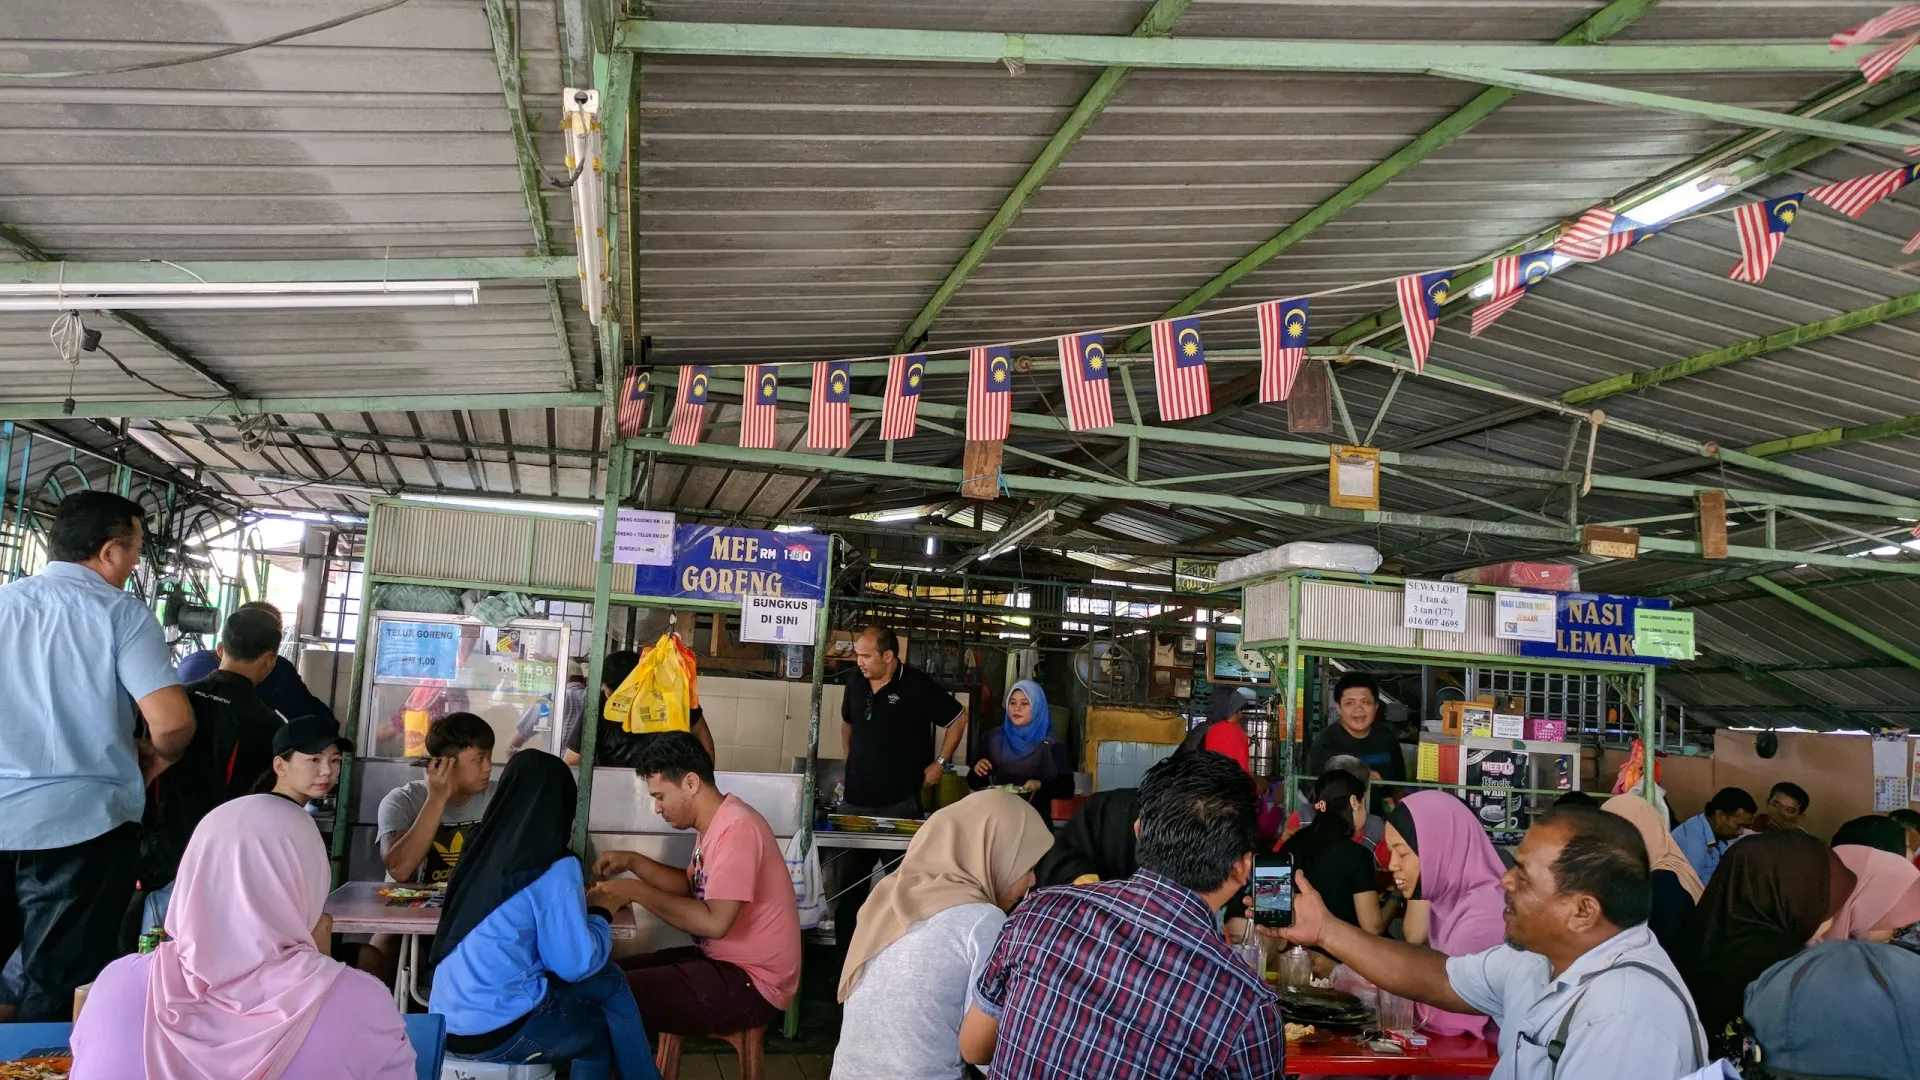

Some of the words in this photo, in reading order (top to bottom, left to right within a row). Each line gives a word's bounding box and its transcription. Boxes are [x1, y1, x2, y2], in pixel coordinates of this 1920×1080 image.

[710, 535, 759, 563] MEE
[760, 548, 777, 560] RM
[682, 565, 782, 598] GORENG
[1408, 582, 1434, 592] SEWA
[1437, 584, 1460, 594] LORI
[753, 599, 808, 610] BUNGKUS
[1419, 594, 1423, 602] 1
[1425, 595, 1439, 604] tan
[1441, 596, 1449, 605] &
[1412, 605, 1418, 613] 3
[1420, 606, 1433, 615] tan
[1568, 599, 1624, 627] NASI
[761, 614, 772, 624] DI
[775, 615, 798, 626] SINI
[1408, 616, 1423, 625] 016
[1424, 618, 1439, 626] 607
[1440, 619, 1459, 629] 4695
[386, 628, 414, 637] TELUR
[416, 630, 453, 640] GORENG
[1557, 629, 1635, 657] LEMAK
[417, 657, 436, 666] 1.00
[1482, 775, 1511, 788] Black
